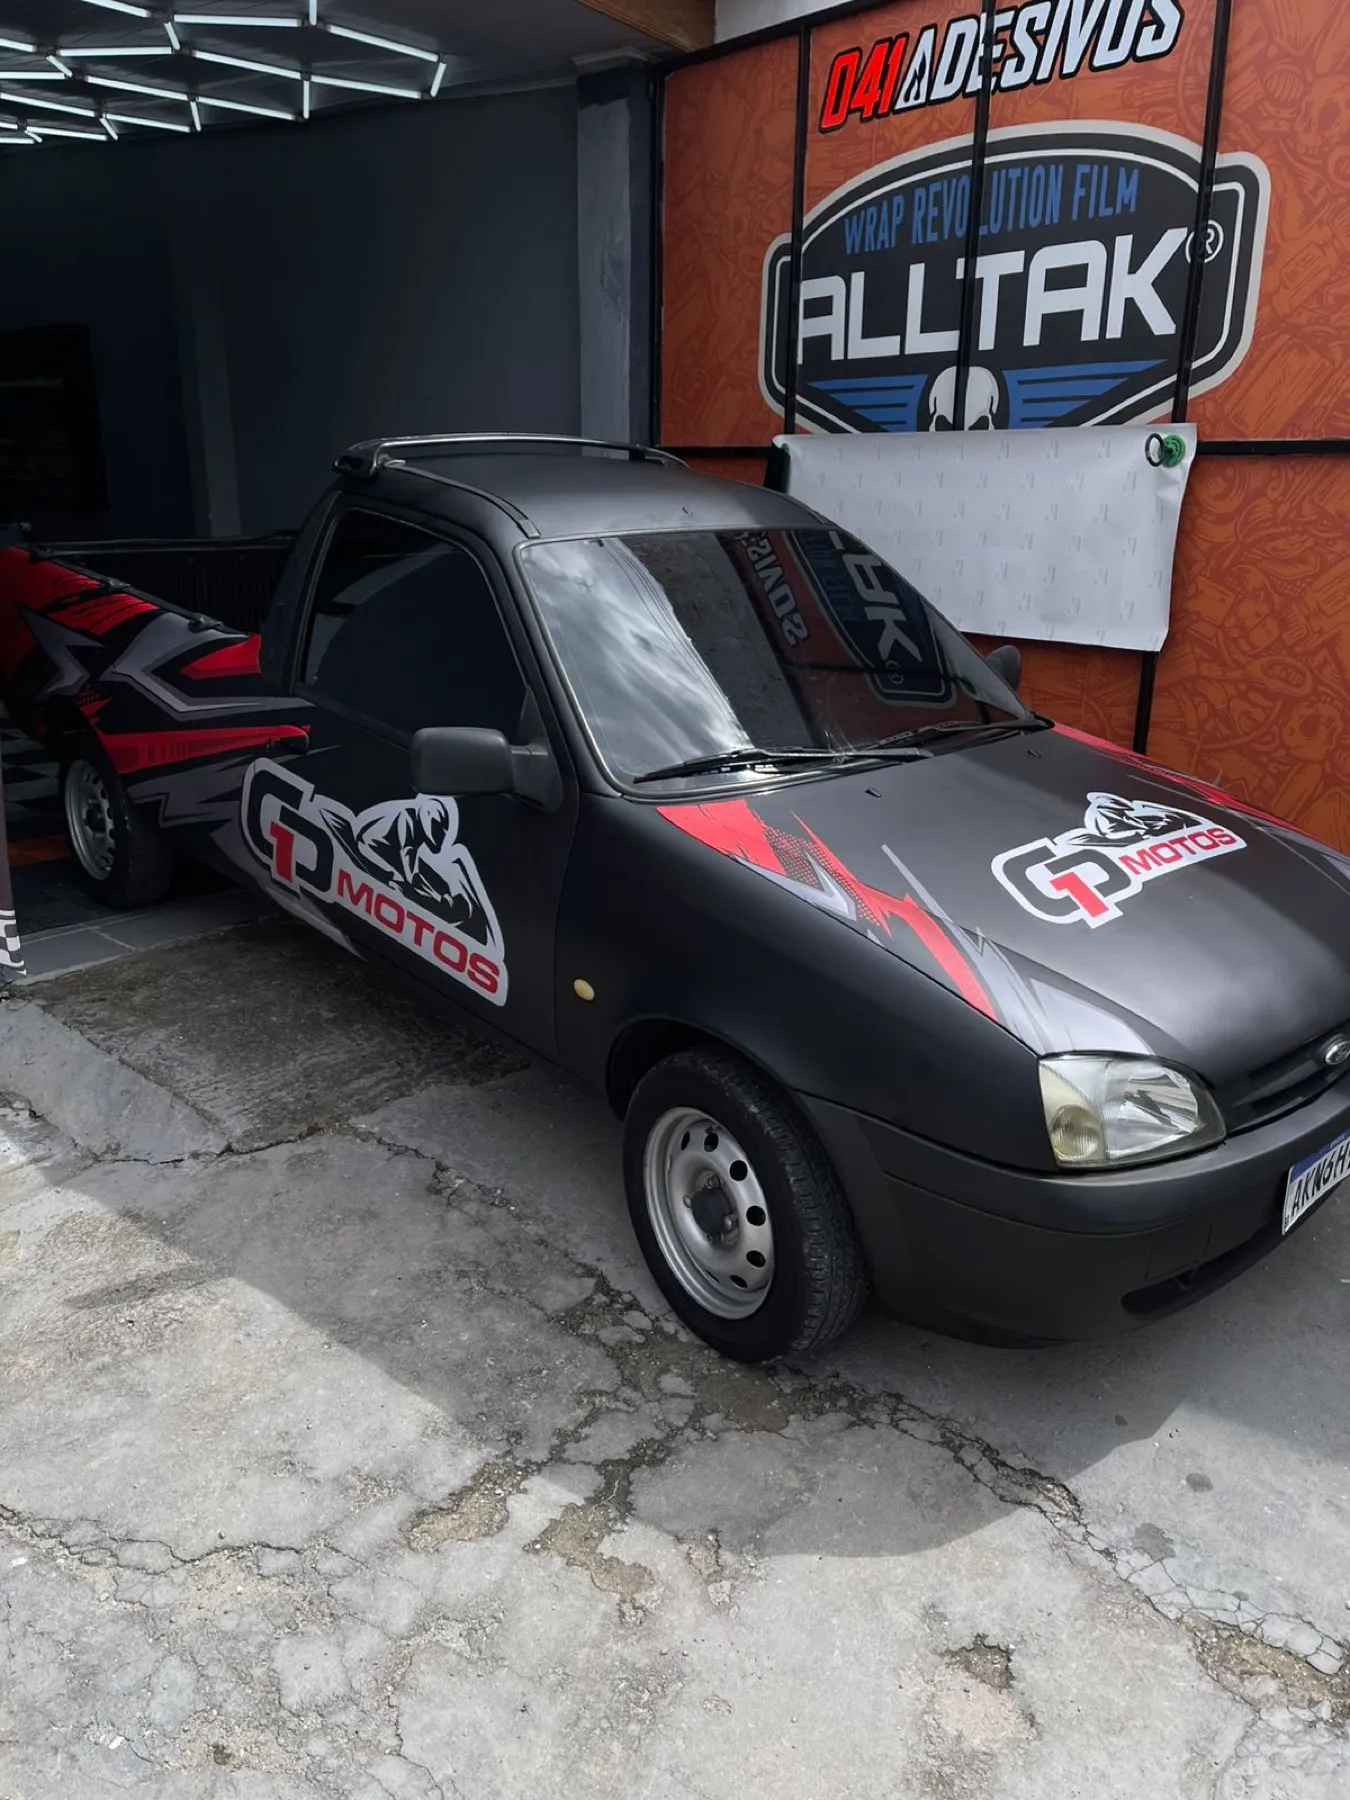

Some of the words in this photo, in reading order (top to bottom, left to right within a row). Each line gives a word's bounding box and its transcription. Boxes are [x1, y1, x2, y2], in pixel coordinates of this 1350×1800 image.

[844, 195, 905, 255] WRAP
[911, 164, 1064, 245] REVOUTION
[1071, 163, 1140, 222] FILM
[1118, 827, 1237, 875] MOTOS
[337, 868, 499, 994] MOTOS
